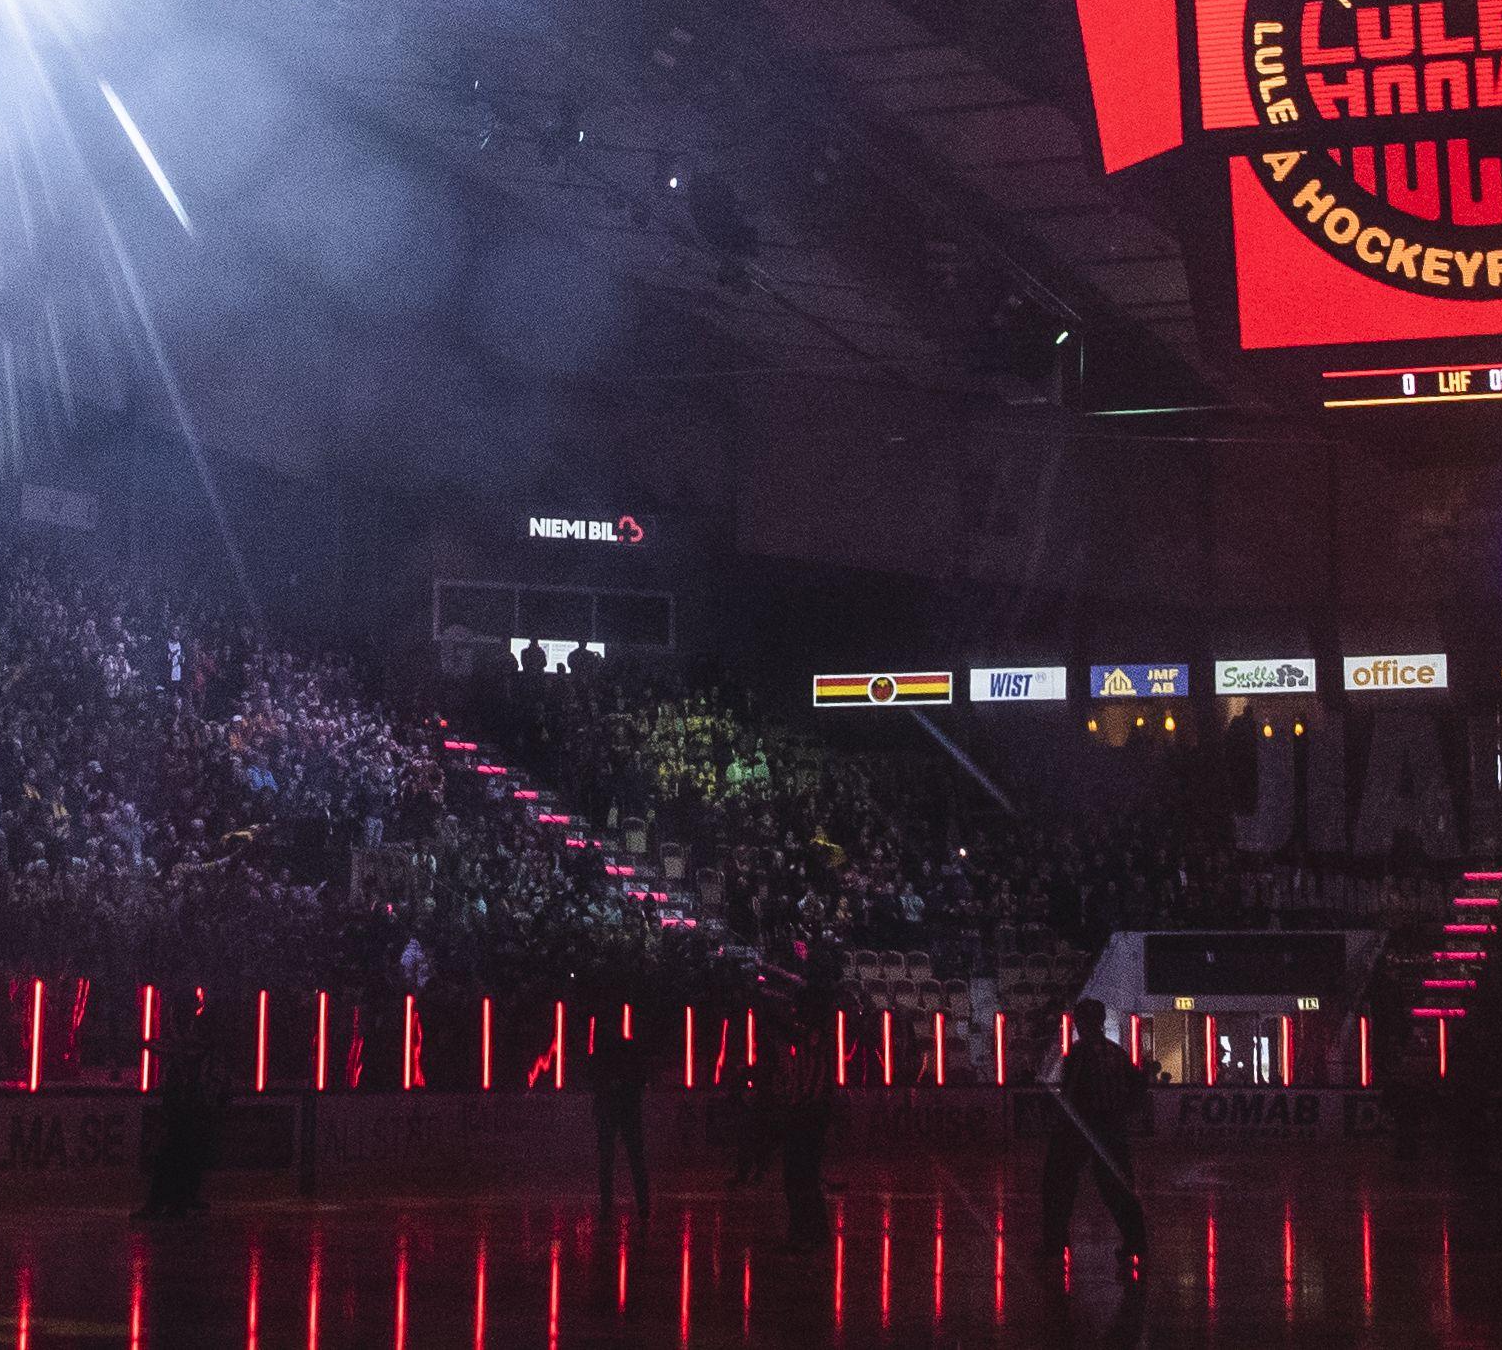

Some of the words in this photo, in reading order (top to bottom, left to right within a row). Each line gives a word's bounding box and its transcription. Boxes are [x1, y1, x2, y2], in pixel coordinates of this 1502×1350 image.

[1402, 373, 1416, 396] 0
[1438, 370, 1471, 394] LHF
[529, 517, 586, 539] NIEMI
[588, 520, 618, 542] BIL
[989, 672, 1033, 698] WIST
[1146, 668, 1180, 681] JMF
[1352, 659, 1435, 687] office
[1150, 681, 1175, 695] AB
